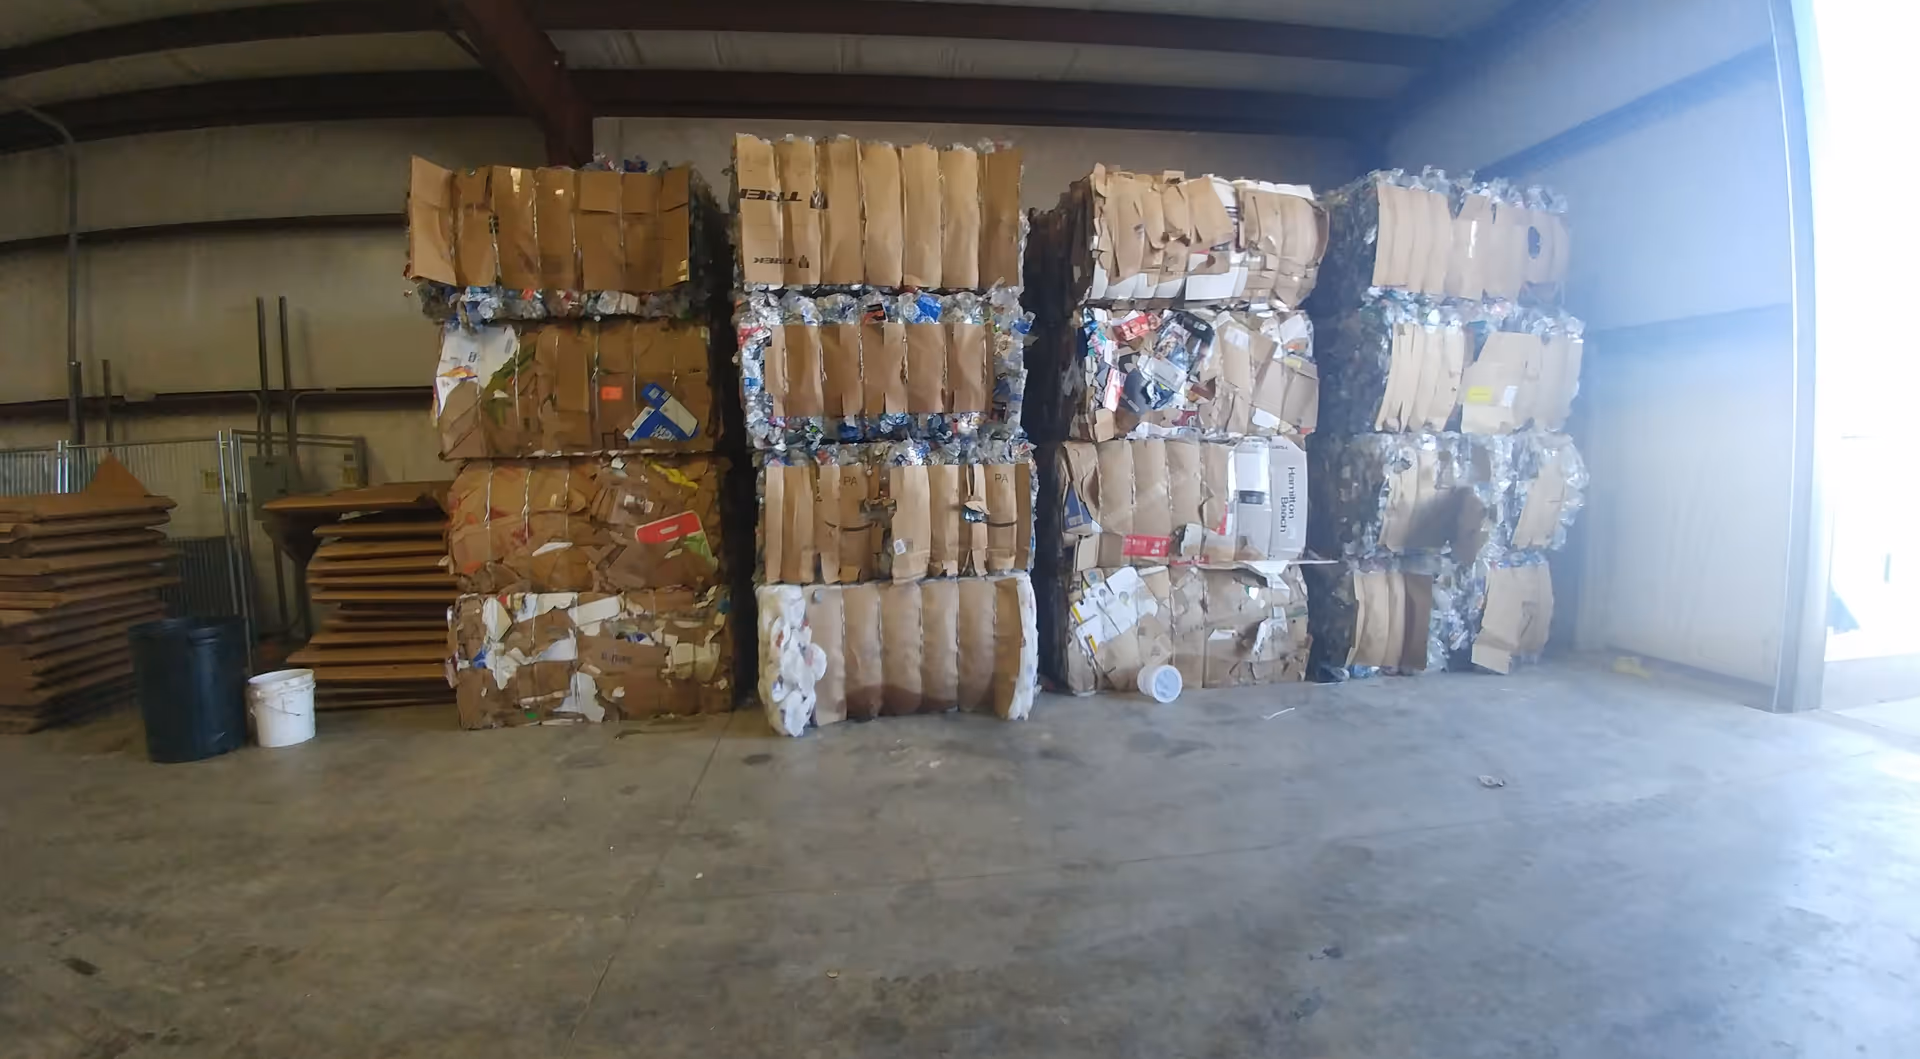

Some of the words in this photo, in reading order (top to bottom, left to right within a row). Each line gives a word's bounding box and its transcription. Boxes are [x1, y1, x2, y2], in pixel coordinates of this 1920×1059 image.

[753, 257, 794, 265] TREK
[1288, 466, 1296, 520] Hamilton
[1280, 496, 1288, 533] Beach
